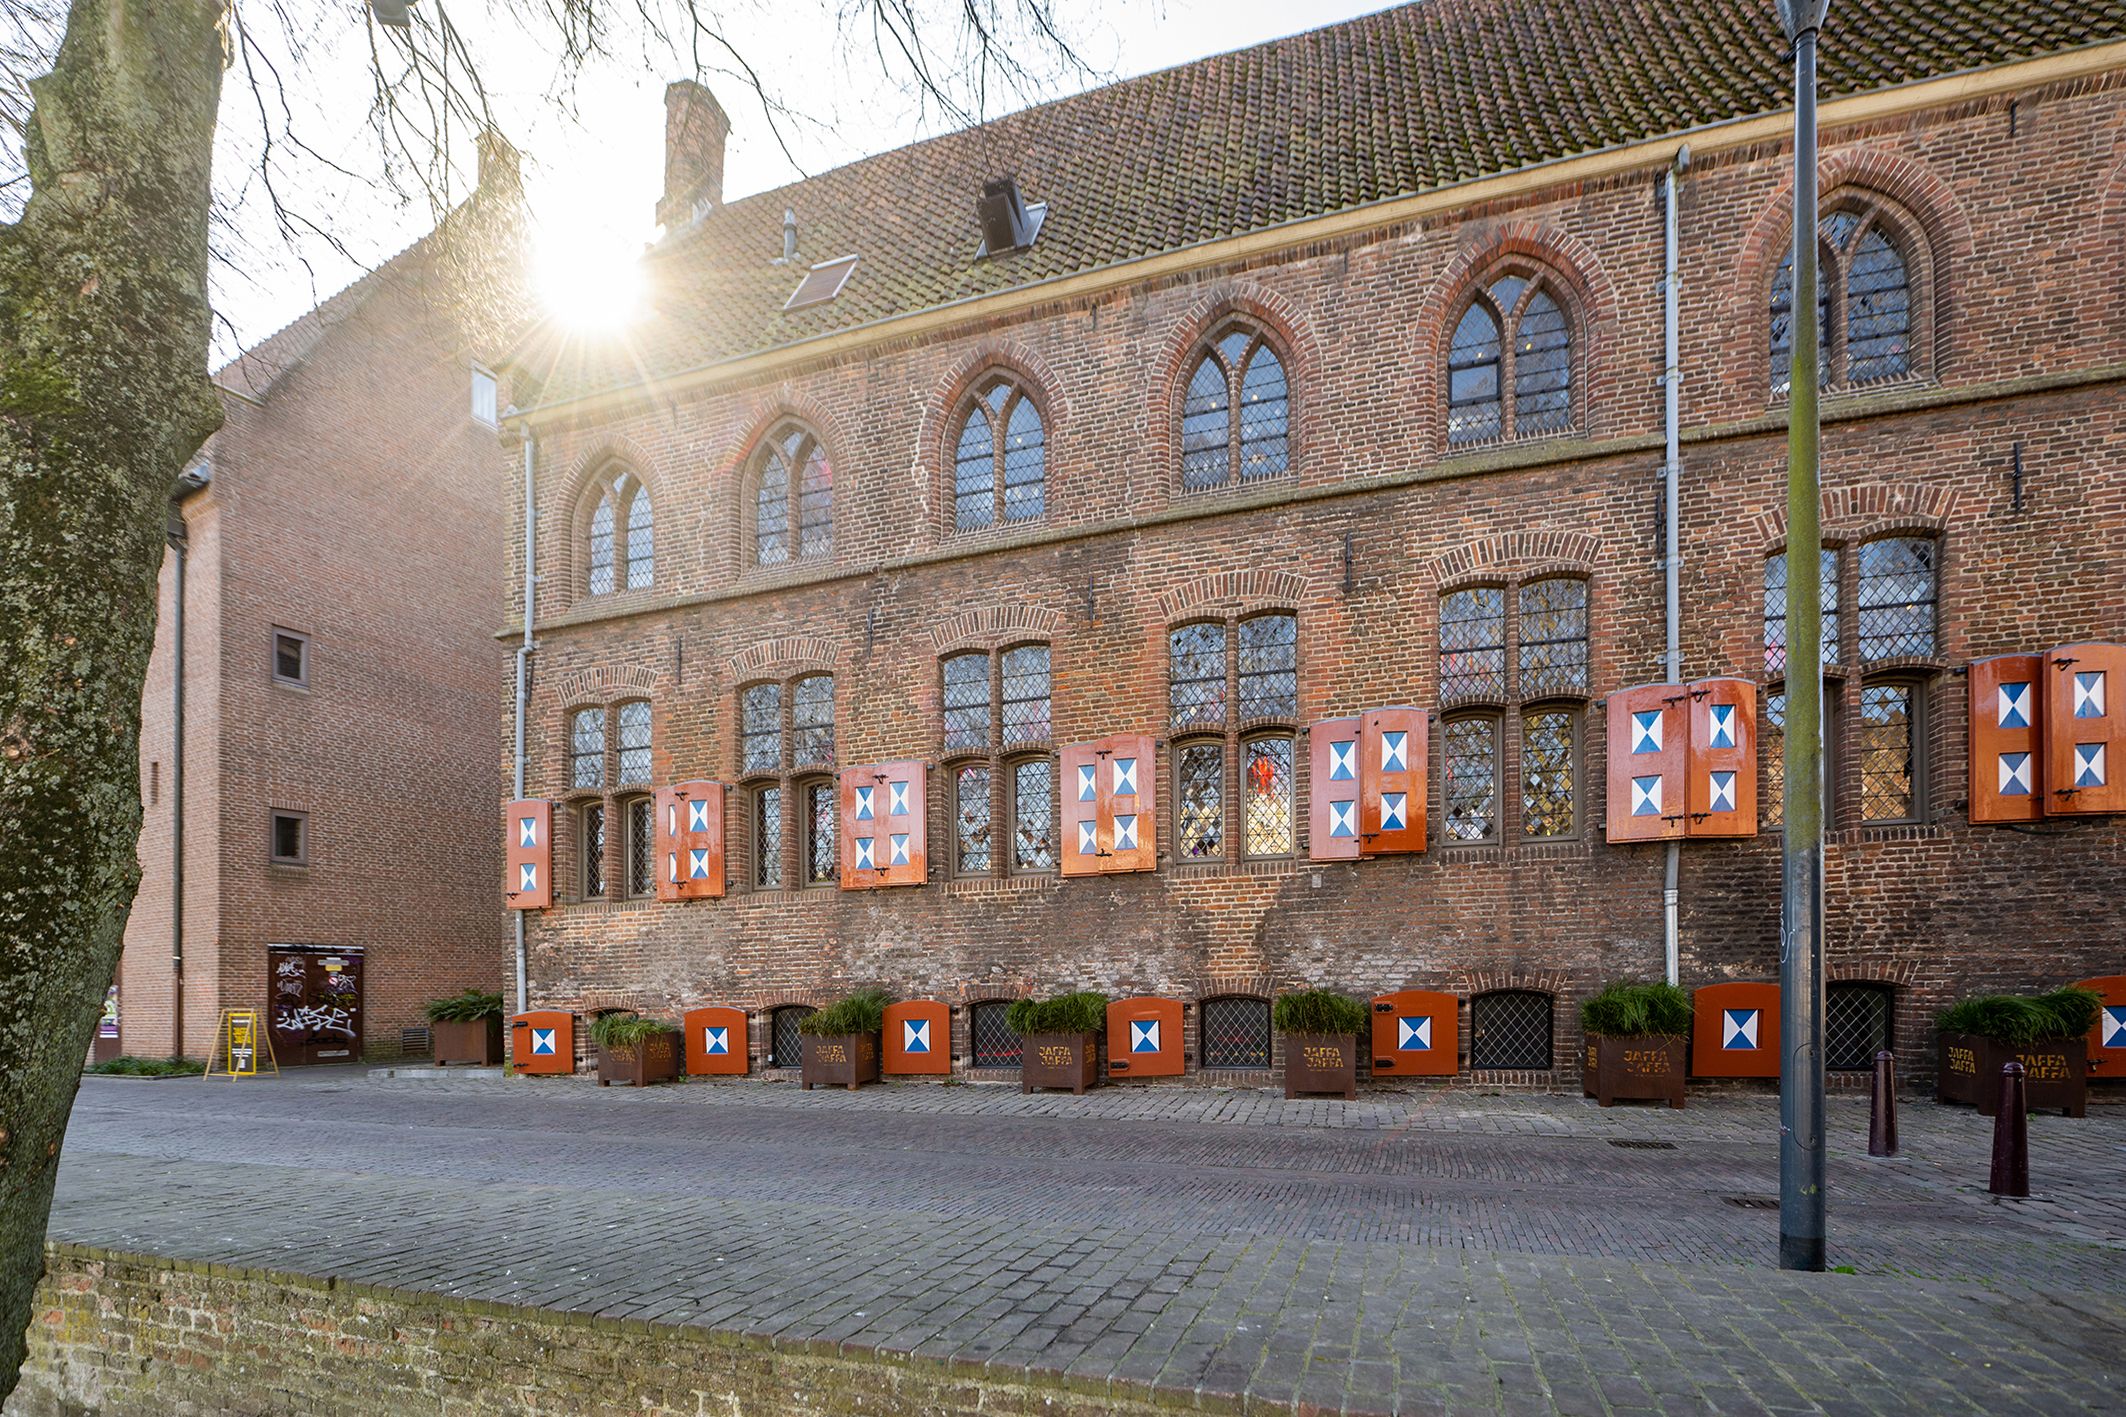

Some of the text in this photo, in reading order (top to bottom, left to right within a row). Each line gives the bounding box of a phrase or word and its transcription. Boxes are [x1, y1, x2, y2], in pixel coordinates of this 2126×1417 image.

[1039, 1046, 1071, 1056] JAFFA
[1303, 1047, 1340, 1057] JAFFA
[1624, 1050, 1668, 1061] JAFFA
[1948, 1047, 1974, 1061] JAFFA
[1041, 1056, 1073, 1065] JAFFA
[1306, 1057, 1344, 1068] JAFFA
[1626, 1062, 1671, 1073] JAFFA
[1950, 1059, 1976, 1074] JAFFA
[2023, 1067, 2071, 1079] AFFA
